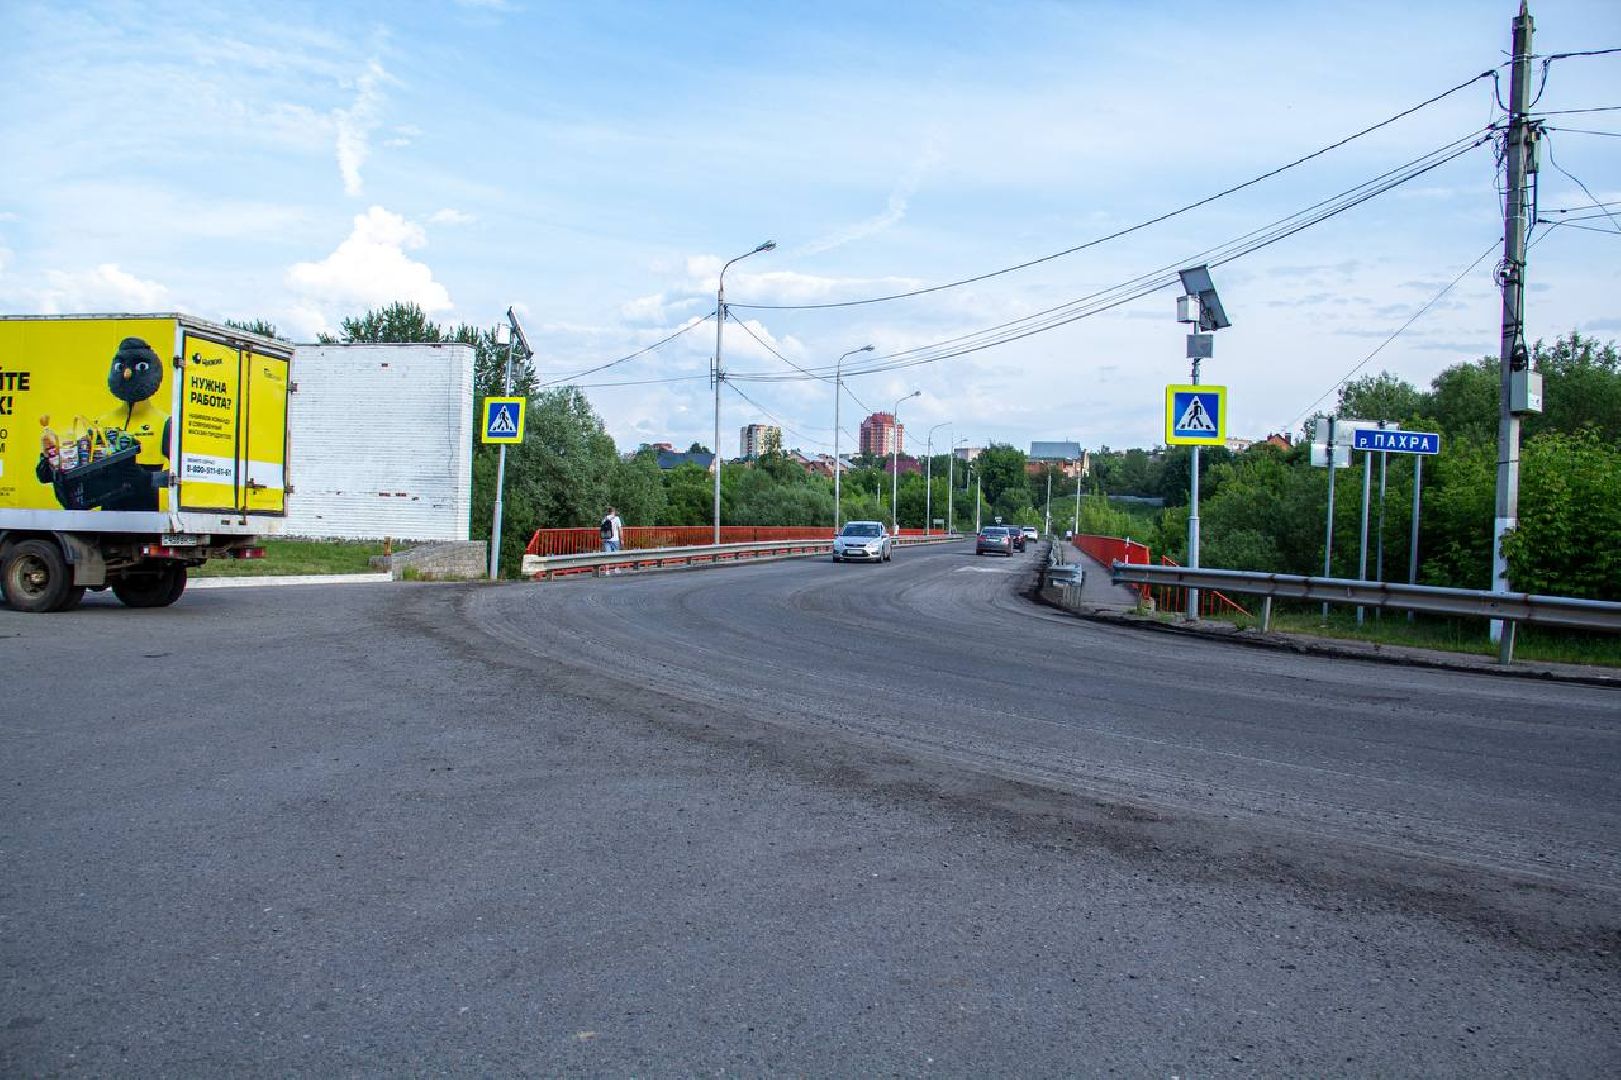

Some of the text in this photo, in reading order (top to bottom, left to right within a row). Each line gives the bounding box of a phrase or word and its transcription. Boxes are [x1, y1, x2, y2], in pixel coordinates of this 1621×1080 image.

[191, 376, 227, 393] НУЖНА
[190, 392, 232, 410] РАБОТА?
[1375, 434, 1429, 449] ПАХРА
